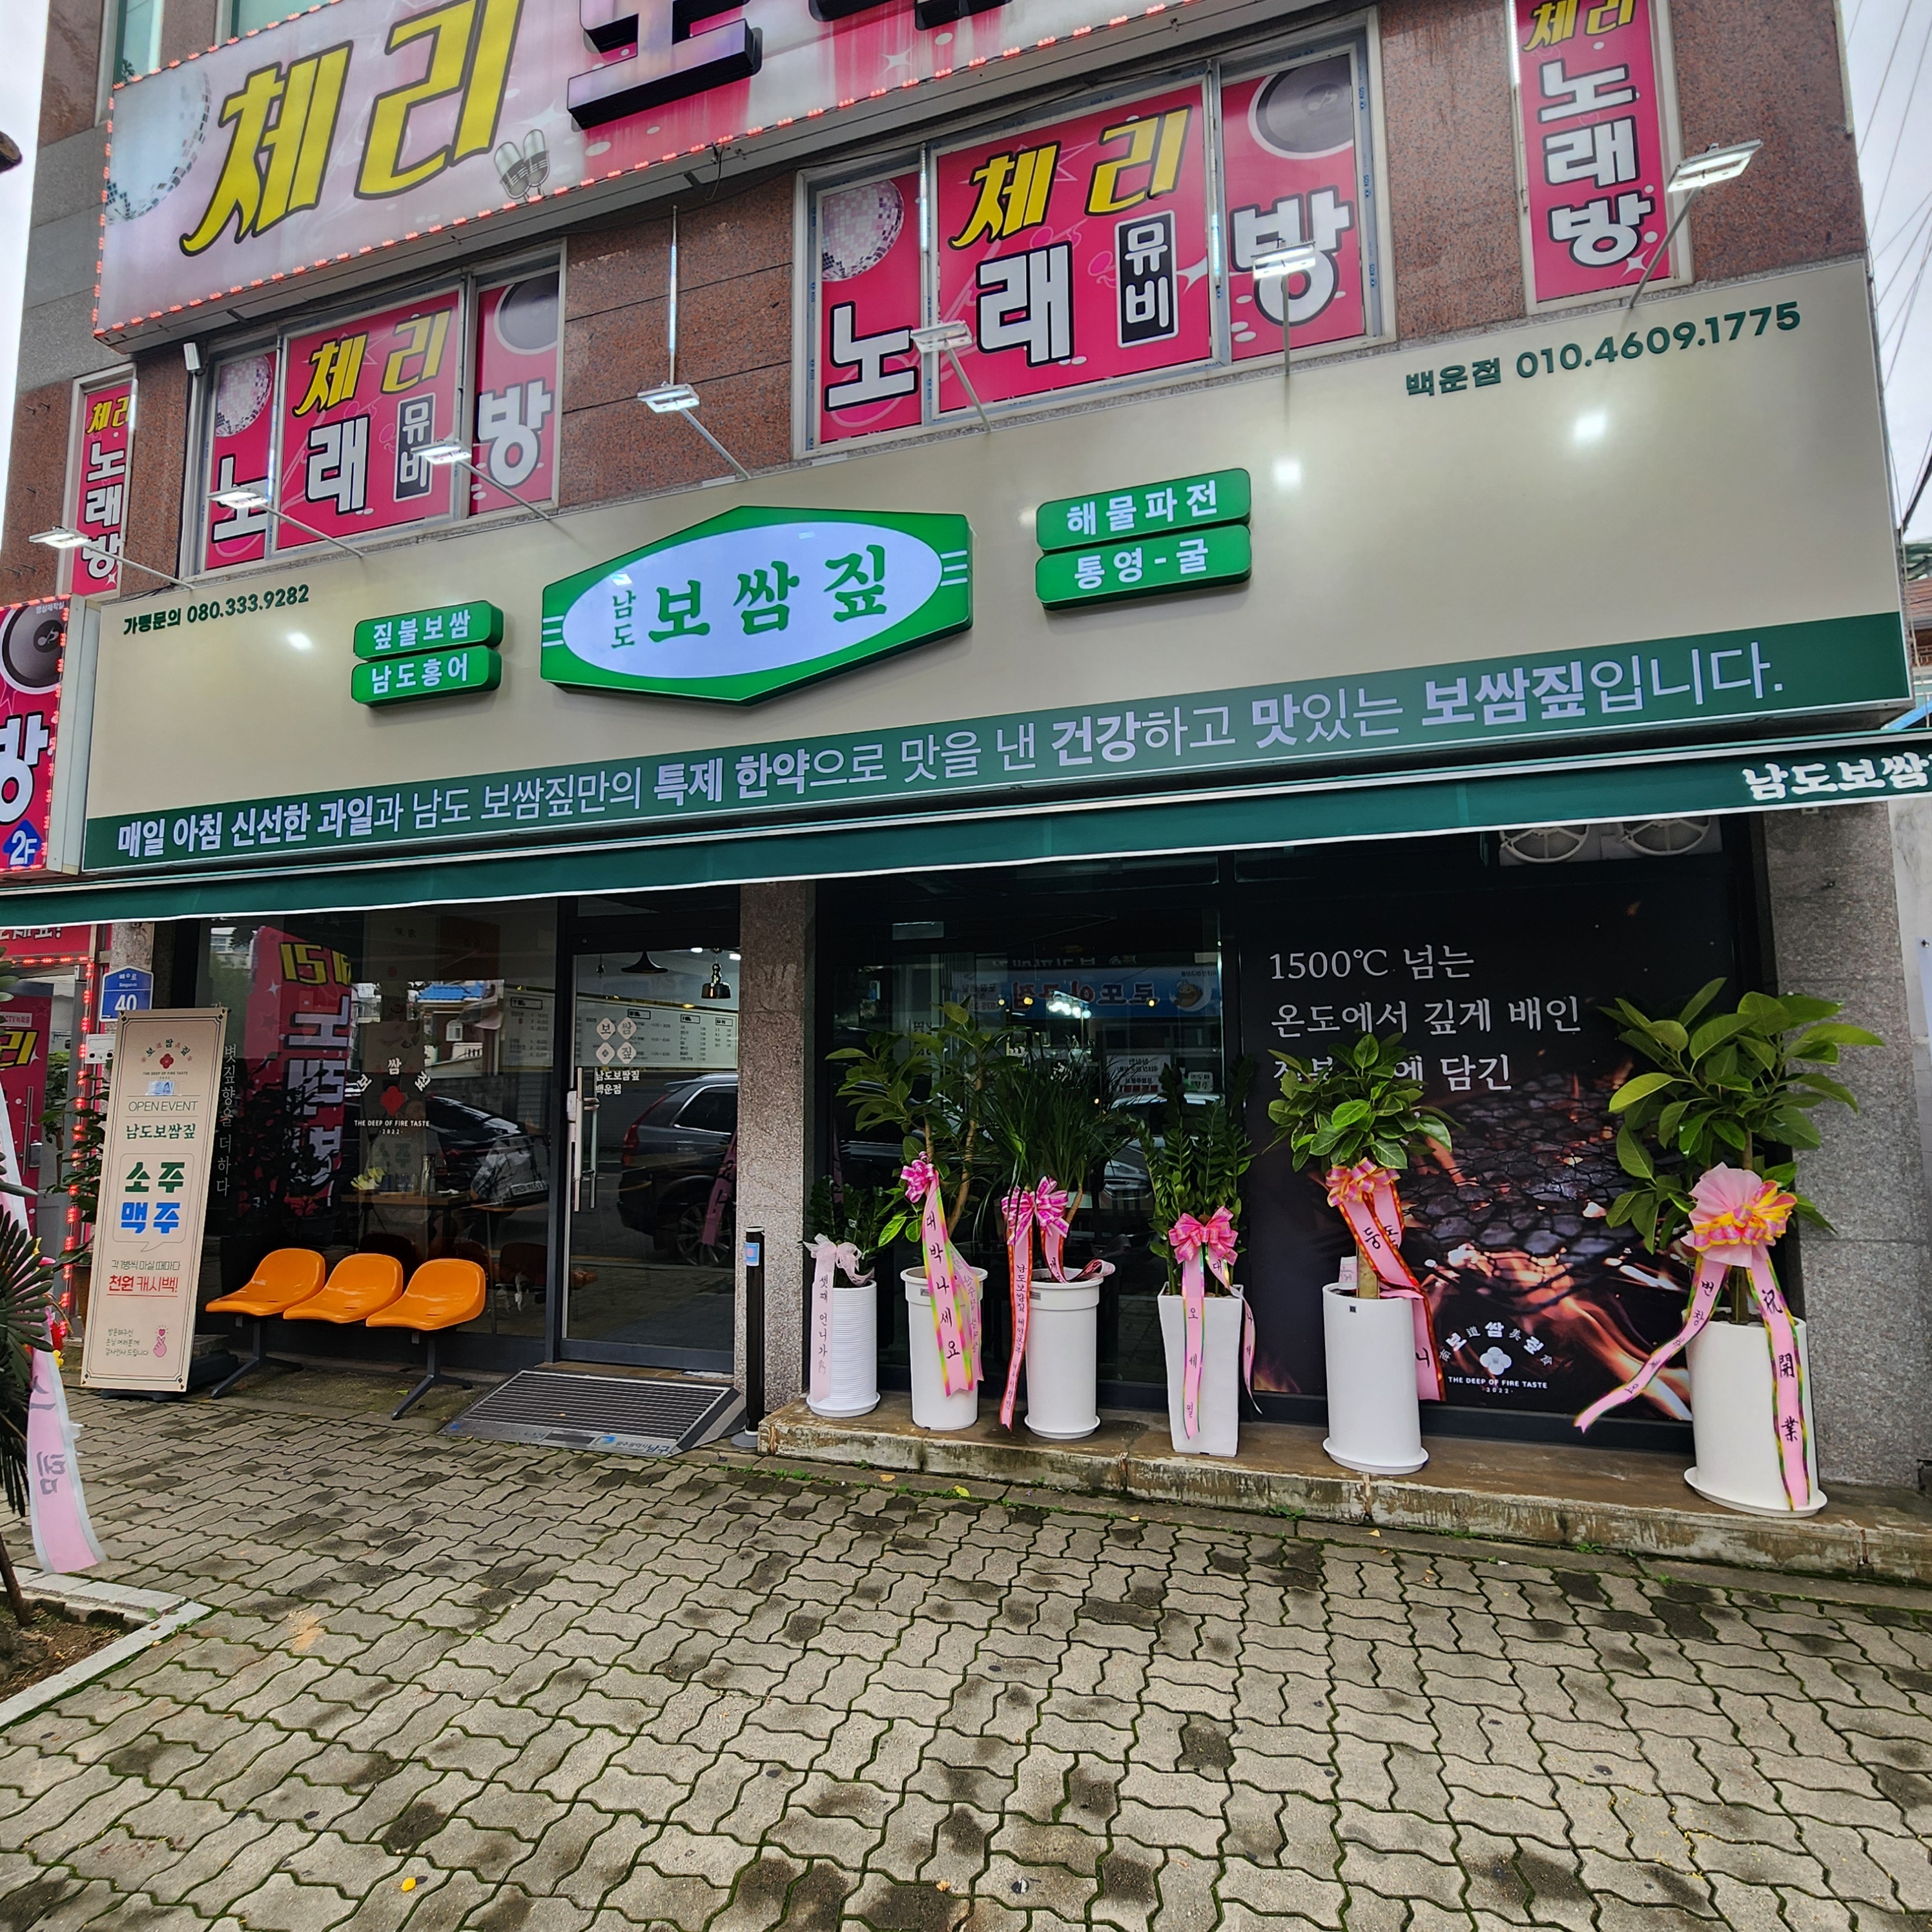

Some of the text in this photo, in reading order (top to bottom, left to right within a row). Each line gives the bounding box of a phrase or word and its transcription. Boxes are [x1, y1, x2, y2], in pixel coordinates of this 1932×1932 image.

[950, 105, 1193, 250] 체리
[1537, 58, 1657, 268] 노래방
[292, 310, 451, 416] 체리
[1406, 300, 1801, 398] 백운점 010.4609.1775
[1067, 480, 1218, 535] 해물파전
[1074, 537, 1209, 590] 통영-굴
[187, 584, 309, 623] 080.333.9282
[611, 544, 889, 650] 남도 보쌈짚
[373, 608, 471, 652] 짚불보쌈
[370, 652, 469, 695] 남도홍어
[118, 642, 1783, 858] 매일 아침 신선한 과일과 남도 보쌈짚만의 특제 한약으로 맛을 낸 건강하고 맛있는 보쌈짚입니다.
[1743, 752, 1932, 801] 남도보쌈
[11, 830, 37, 865] 2F
[1403, 945, 1475, 981] 넘는
[114, 994, 138, 1011] 40
[1271, 995, 1581, 1038] 온도에서 깊게 배인
[595, 1070, 640, 1082] 남도보쌈짚
[595, 1084, 622, 1095] 백운점
[1440, 1054, 1513, 1092] 담긴
[128, 1101, 198, 1112] OPEN EVENT
[126, 1123, 196, 1140] 남도보쌈짚
[125, 1161, 185, 1193] 소주
[216, 1134, 232, 1197] 더하다
[120, 1202, 181, 1234] 맥주
[108, 1275, 179, 1293] 천원 캐시백!
[926, 1211, 961, 1359] 대박나세요
[1522, 1381, 1548, 1389] TASTE
[646, 1444, 670, 1454] 남구
